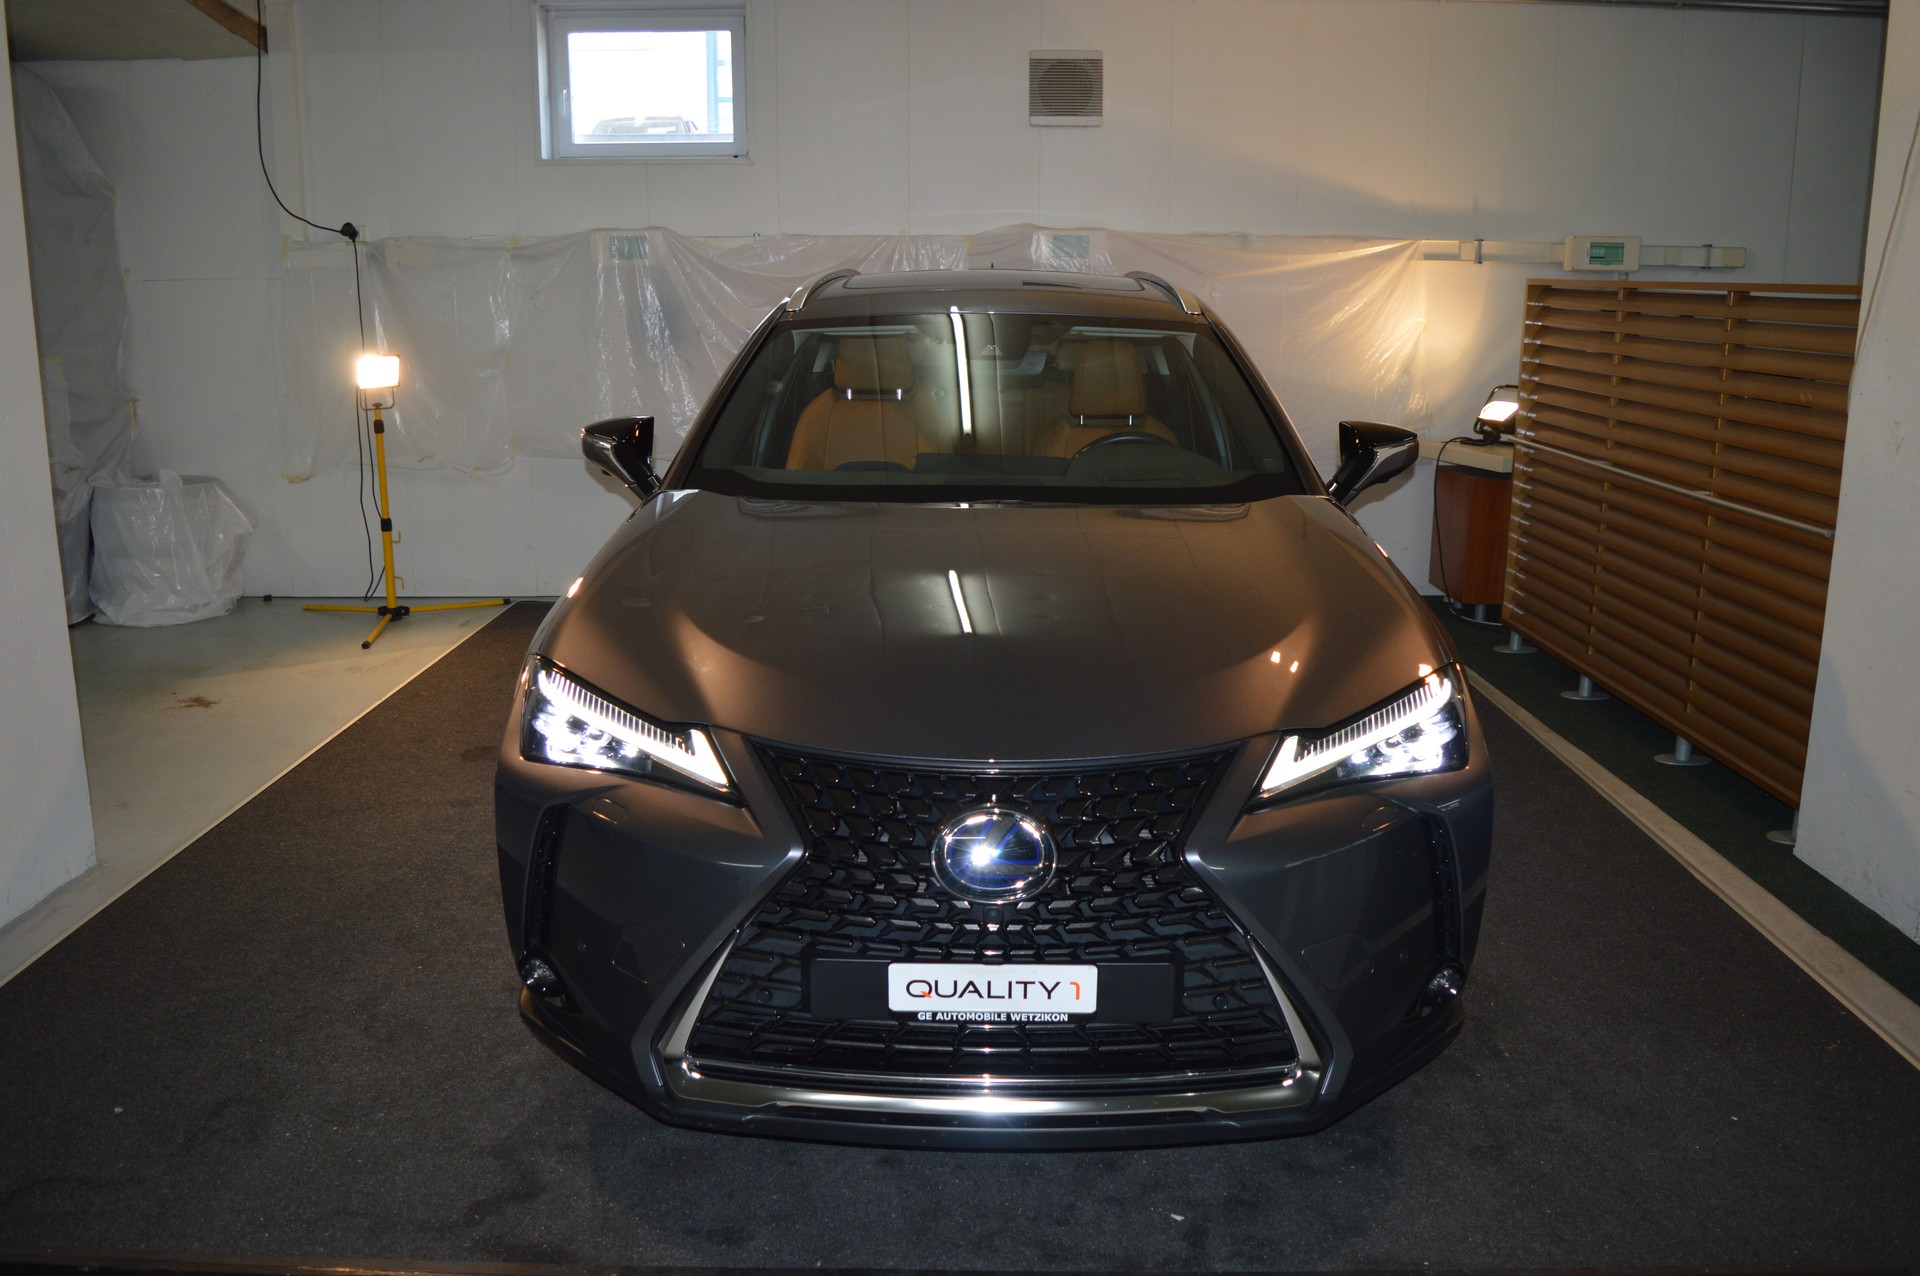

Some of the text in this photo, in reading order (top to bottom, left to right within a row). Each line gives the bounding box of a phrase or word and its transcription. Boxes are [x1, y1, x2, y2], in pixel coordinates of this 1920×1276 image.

[906, 980, 1081, 1000] QUALITY 1
[917, 1012, 1069, 1022] GE AUTOMOBILE WETZIKON
